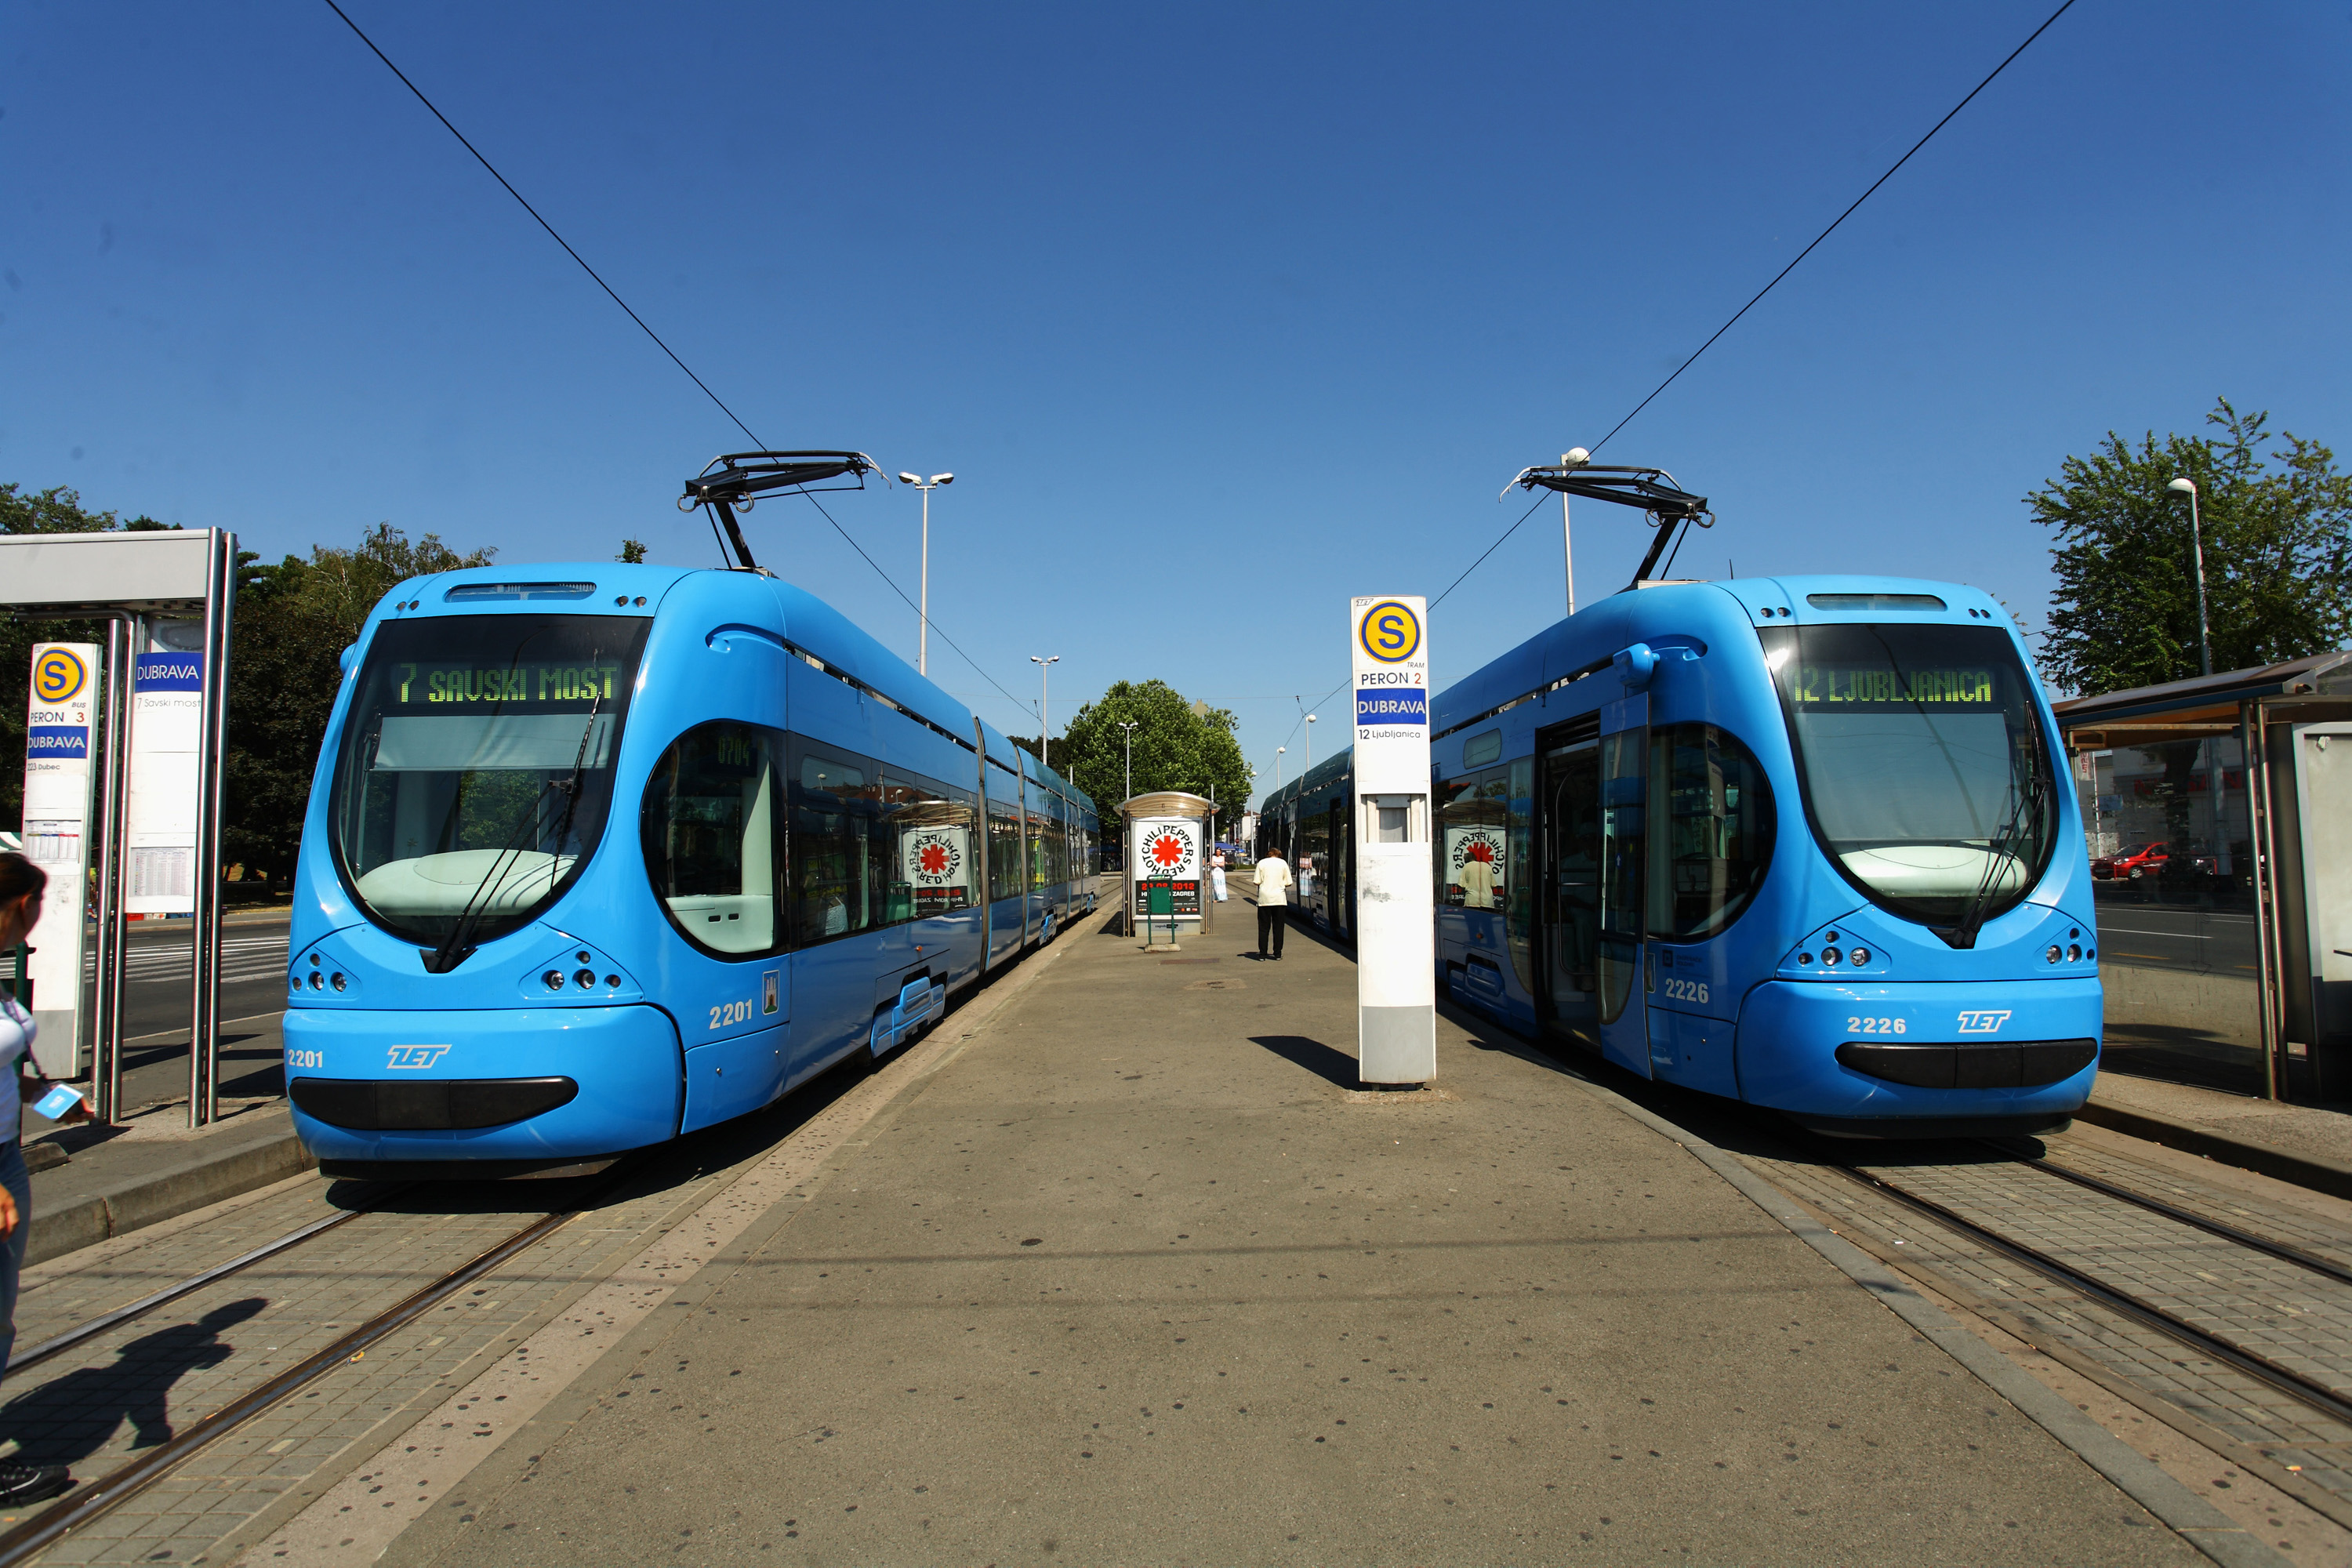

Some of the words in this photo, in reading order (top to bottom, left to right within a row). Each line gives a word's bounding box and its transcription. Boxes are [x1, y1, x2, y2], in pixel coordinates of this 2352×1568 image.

[1378, 615, 1405, 649] S
[44, 660, 67, 691] S
[137, 665, 199, 681] DUBRAVA
[400, 663, 416, 702] 7
[539, 667, 617, 700] MOST
[1361, 673, 1408, 685] PERON
[1414, 673, 1421, 684] 2
[1791, 666, 1819, 701] 12
[1829, 671, 1991, 702] LJUBLJANICA
[137, 698, 142, 709] 7
[144, 699, 171, 707] Savski
[1358, 700, 1425, 714] DUBRAVA
[31, 712, 64, 723] PERON
[76, 712, 85, 722] 3
[28, 736, 85, 749] DUBRAVA
[1359, 729, 1370, 739] 12
[1372, 730, 1420, 739] Ljubljanica
[1142, 827, 1162, 854] CHILI
[1163, 826, 1194, 865] PEPPERS
[1142, 855, 1160, 875] HOT
[1665, 978, 1708, 1004] 2226
[710, 999, 752, 1029] 2201
[1957, 1010, 2012, 1033] ZET
[1847, 1017, 1906, 1033] 2226
[288, 1049, 323, 1068] 2201
[387, 1044, 452, 1069] ZET
